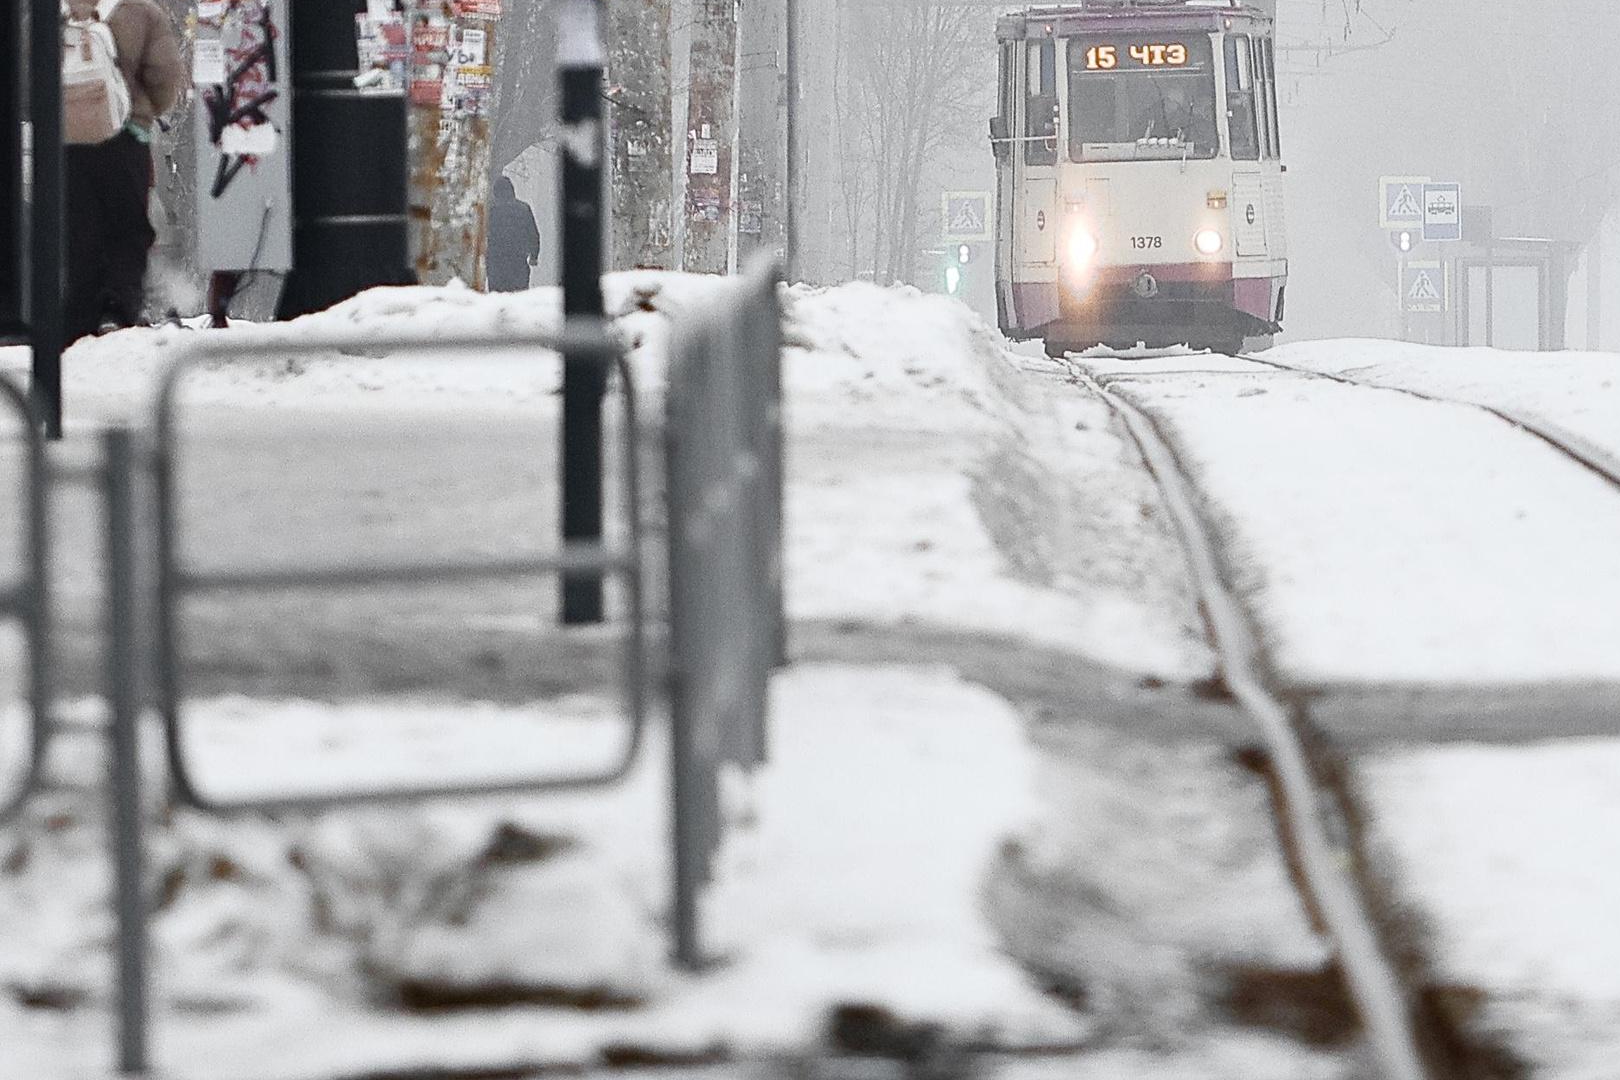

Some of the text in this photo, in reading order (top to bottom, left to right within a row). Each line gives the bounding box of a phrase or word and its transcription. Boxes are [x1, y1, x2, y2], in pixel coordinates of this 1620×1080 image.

[1086, 43, 1186, 69] 15 ЧТЗ
[1130, 236, 1162, 249] 1378
